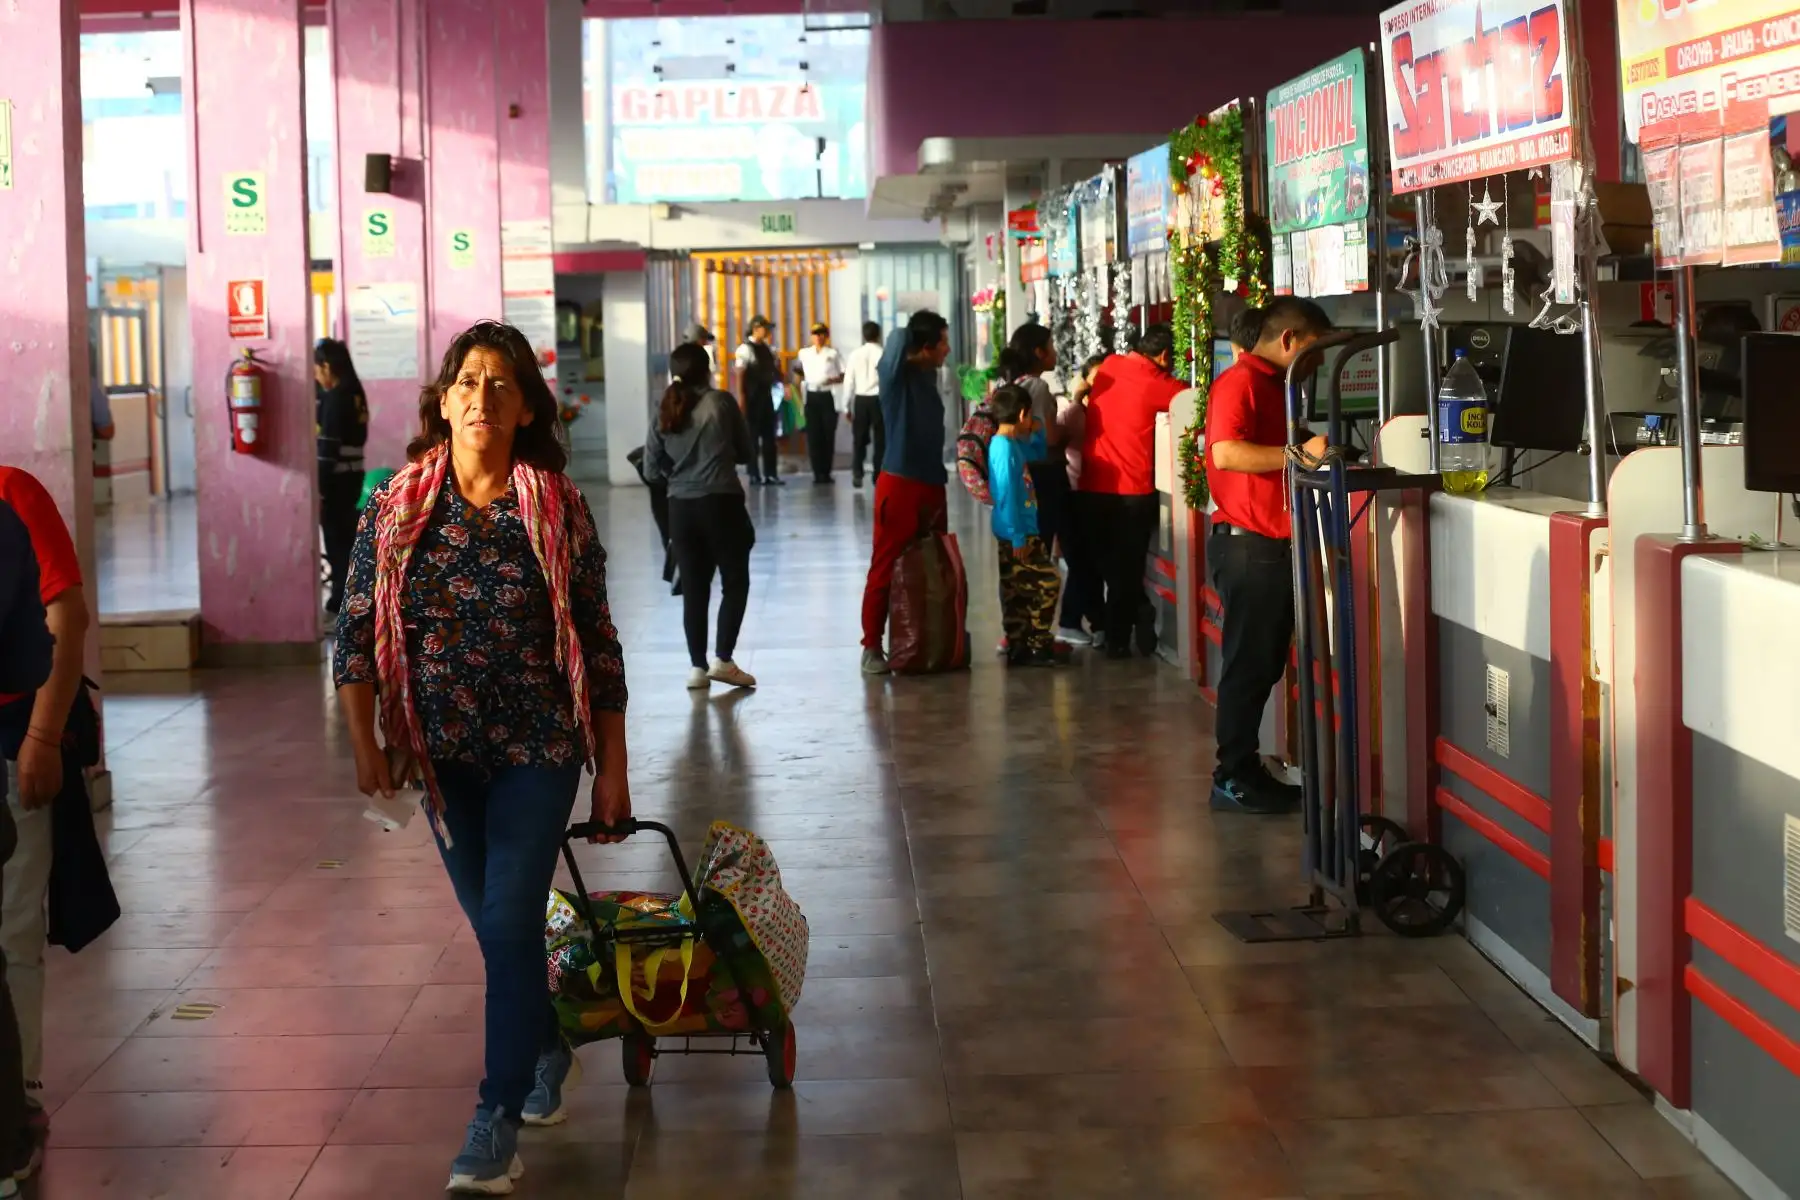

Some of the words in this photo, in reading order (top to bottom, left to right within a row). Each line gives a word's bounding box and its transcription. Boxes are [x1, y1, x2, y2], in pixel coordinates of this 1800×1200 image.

[1677, 40, 1713, 71] OROYA
[1720, 28, 1755, 60] JAUJA
[1274, 74, 1356, 167] NACIONAL
[231, 177, 258, 208] S
[368, 212, 389, 236] S
[761, 213, 792, 233] SALIDA
[452, 231, 471, 252] S
